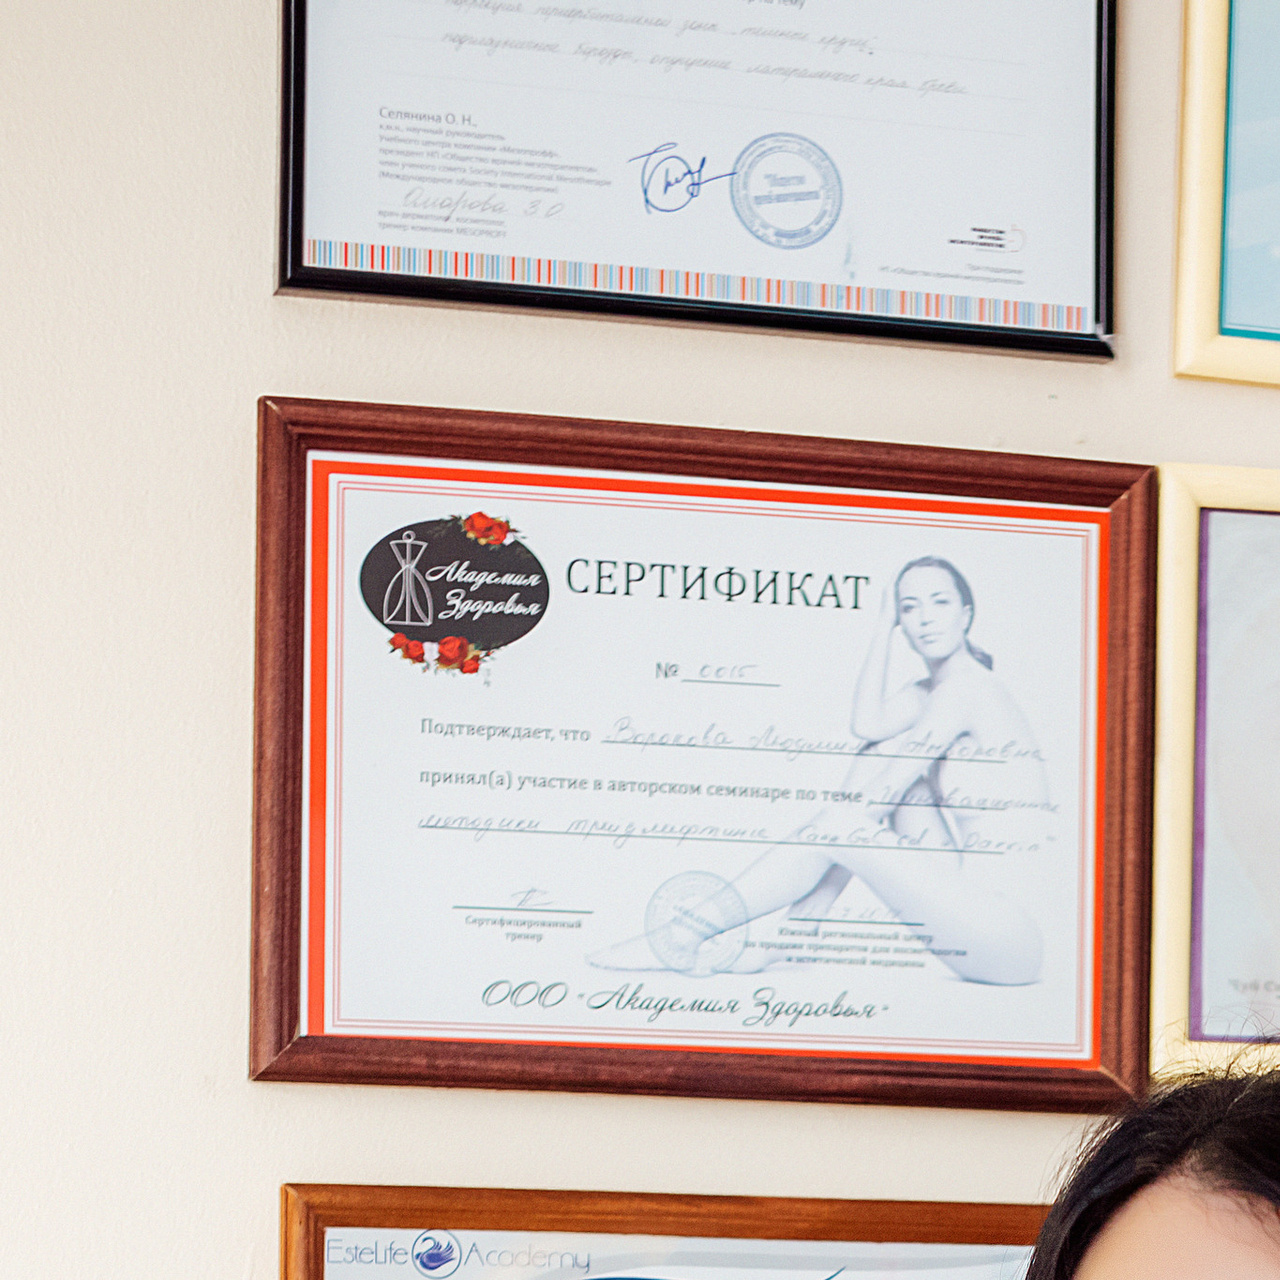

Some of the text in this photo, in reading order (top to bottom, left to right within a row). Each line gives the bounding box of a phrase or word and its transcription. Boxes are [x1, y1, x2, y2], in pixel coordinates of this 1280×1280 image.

[378, 106, 443, 125] Селянина
[444, 112, 460, 126] О.
[425, 558, 542, 591] Академия
[566, 557, 871, 611] СЕРТИФИКАТ
[438, 588, 542, 621] Здоровья
[420, 717, 556, 743] Подтверждает,
[559, 728, 592, 742] что
[419, 767, 864, 804] принял(а) участие в авторском семинаре по теме
[464, 913, 584, 930] Сертифицированный
[504, 930, 544, 943] тренер
[821, 929, 900, 943] региональный
[481, 979, 570, 1009] ООО
[326, 1238, 591, 1275] EsteLife Academy
